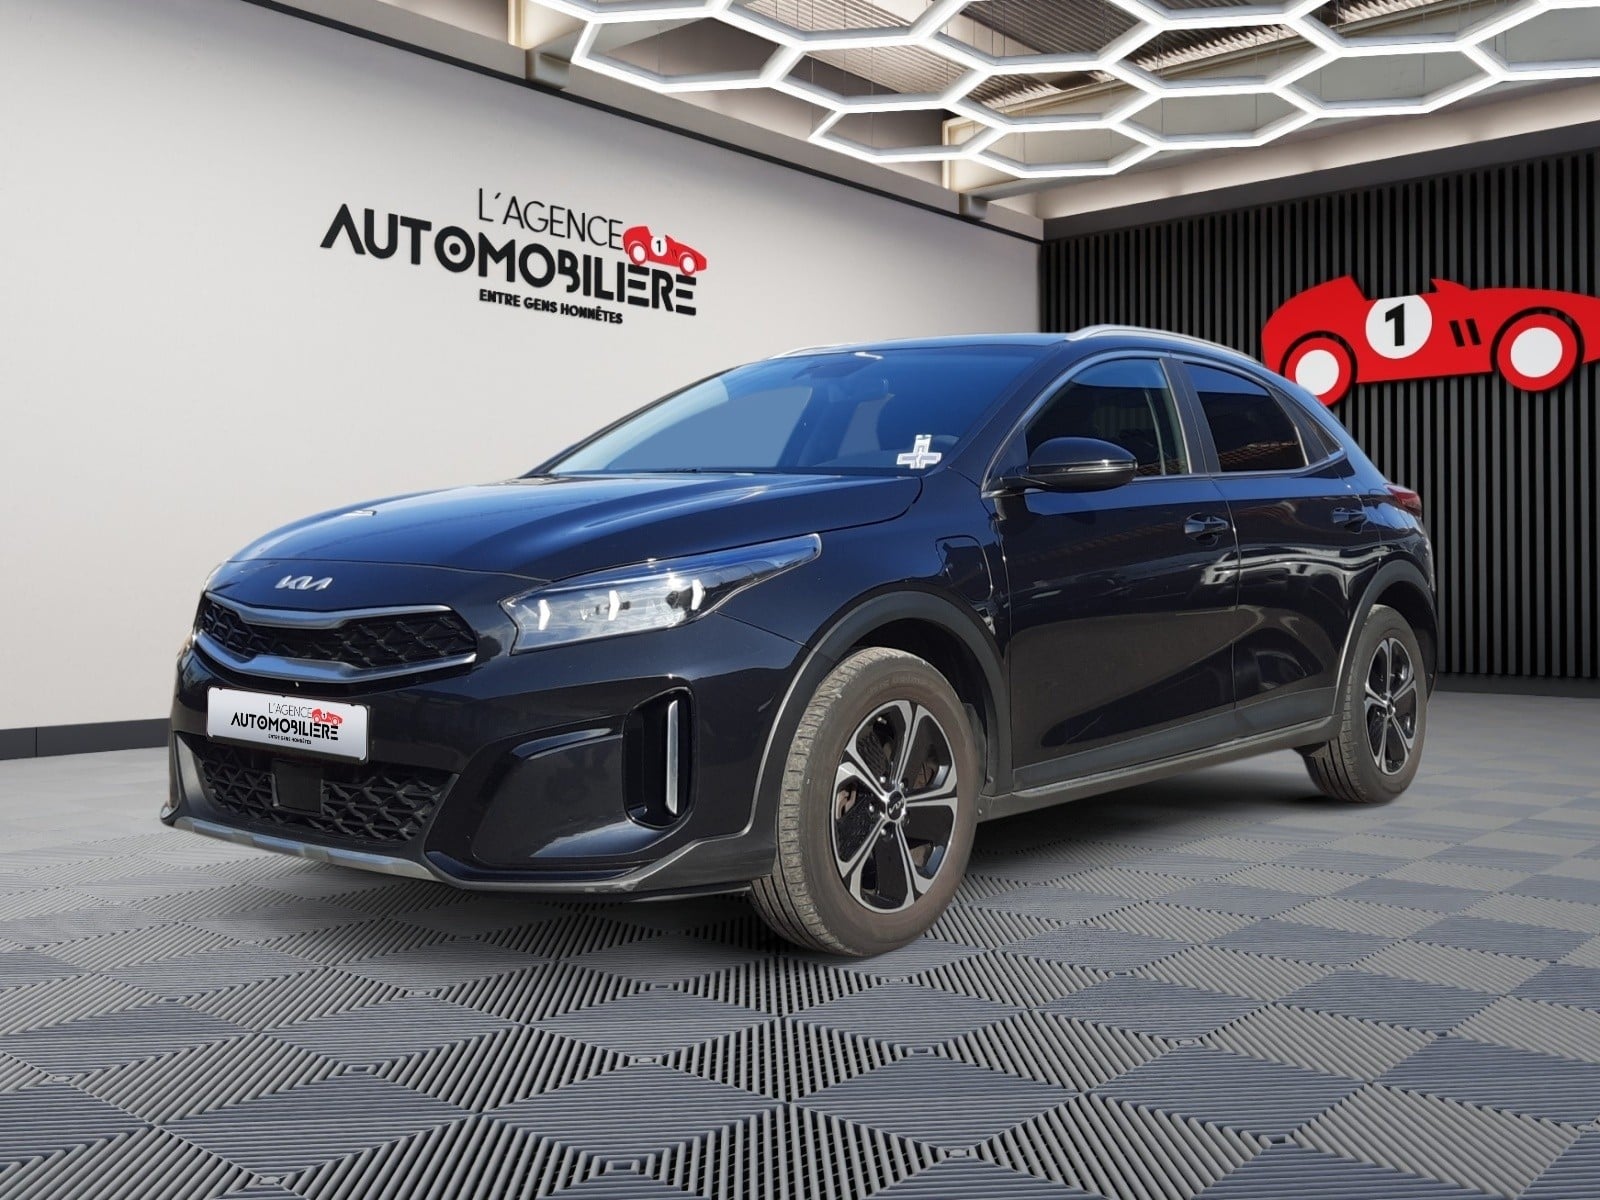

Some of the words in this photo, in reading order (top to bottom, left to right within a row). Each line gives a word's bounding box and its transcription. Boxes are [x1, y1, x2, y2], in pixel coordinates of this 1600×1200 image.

[478, 188, 623, 251] L'AGENCE
[656, 239, 662, 253] 1
[479, 289, 521, 307] ENTRE
[523, 297, 558, 313] GENS
[560, 303, 623, 324] HONNÊTES
[1385, 303, 1405, 347] 1
[274, 575, 333, 591] KIA
[268, 702, 313, 719] L'AGENCE
